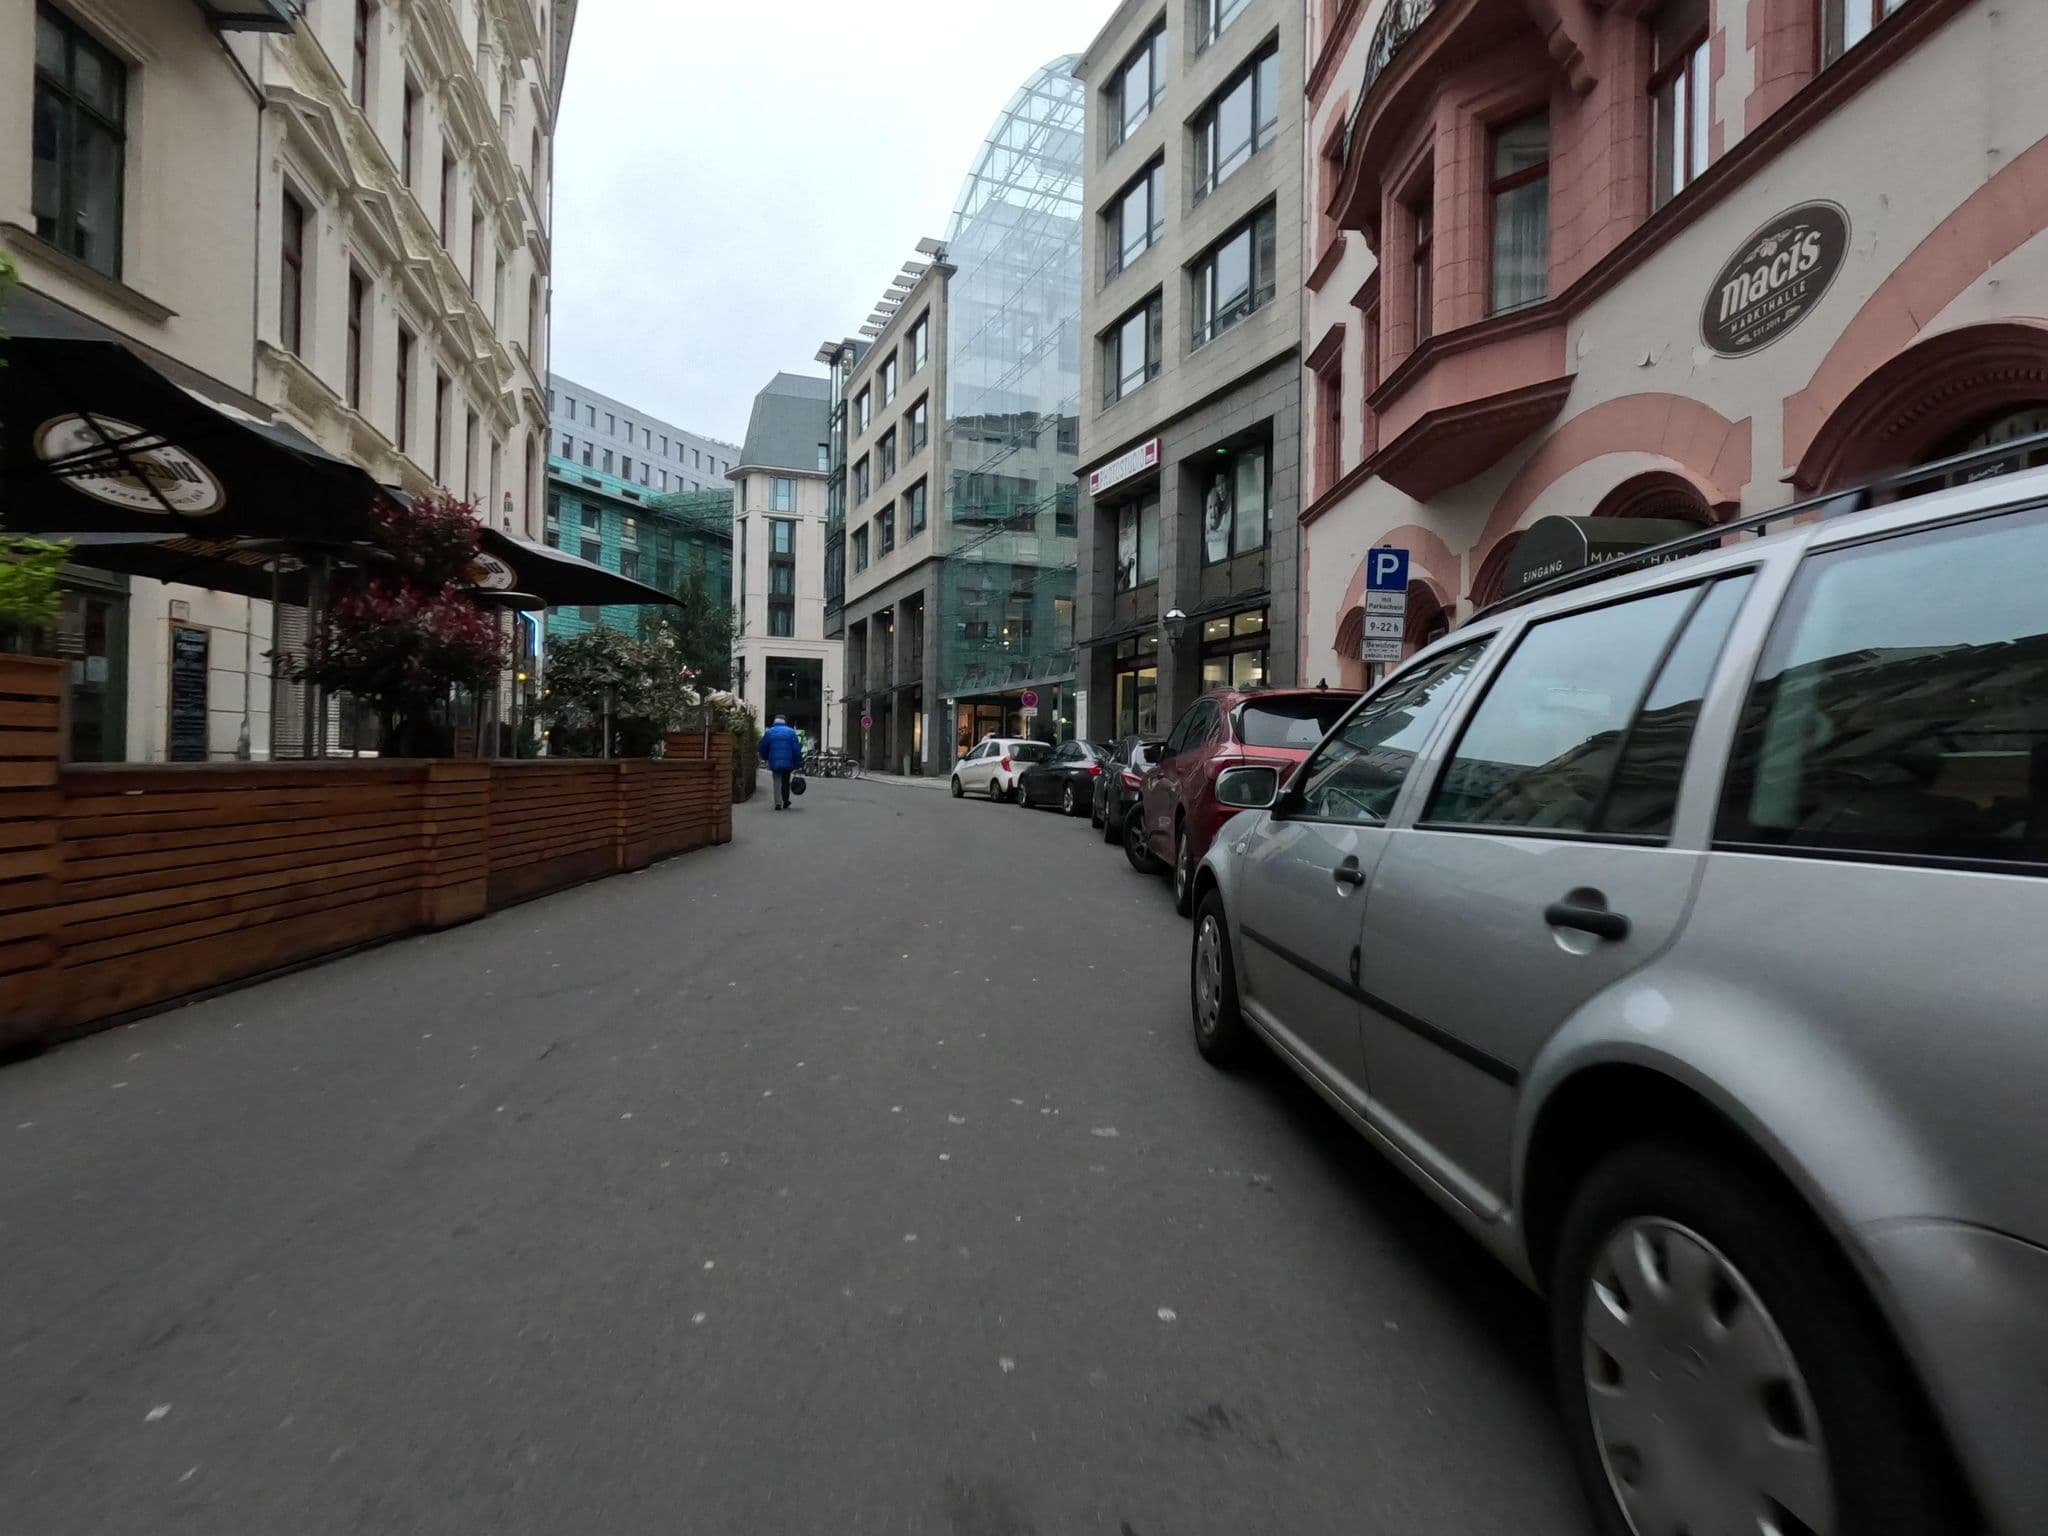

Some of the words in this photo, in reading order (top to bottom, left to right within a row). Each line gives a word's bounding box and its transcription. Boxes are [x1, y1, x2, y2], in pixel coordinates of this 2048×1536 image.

[1720, 231, 1822, 323] macis
[1731, 280, 1806, 334] MARKTHALLE
[1376, 553, 1399, 585] P
[1523, 559, 1562, 583] EINGANG
[1370, 622, 1392, 632] 9-22
[1393, 623, 1399, 632] h
